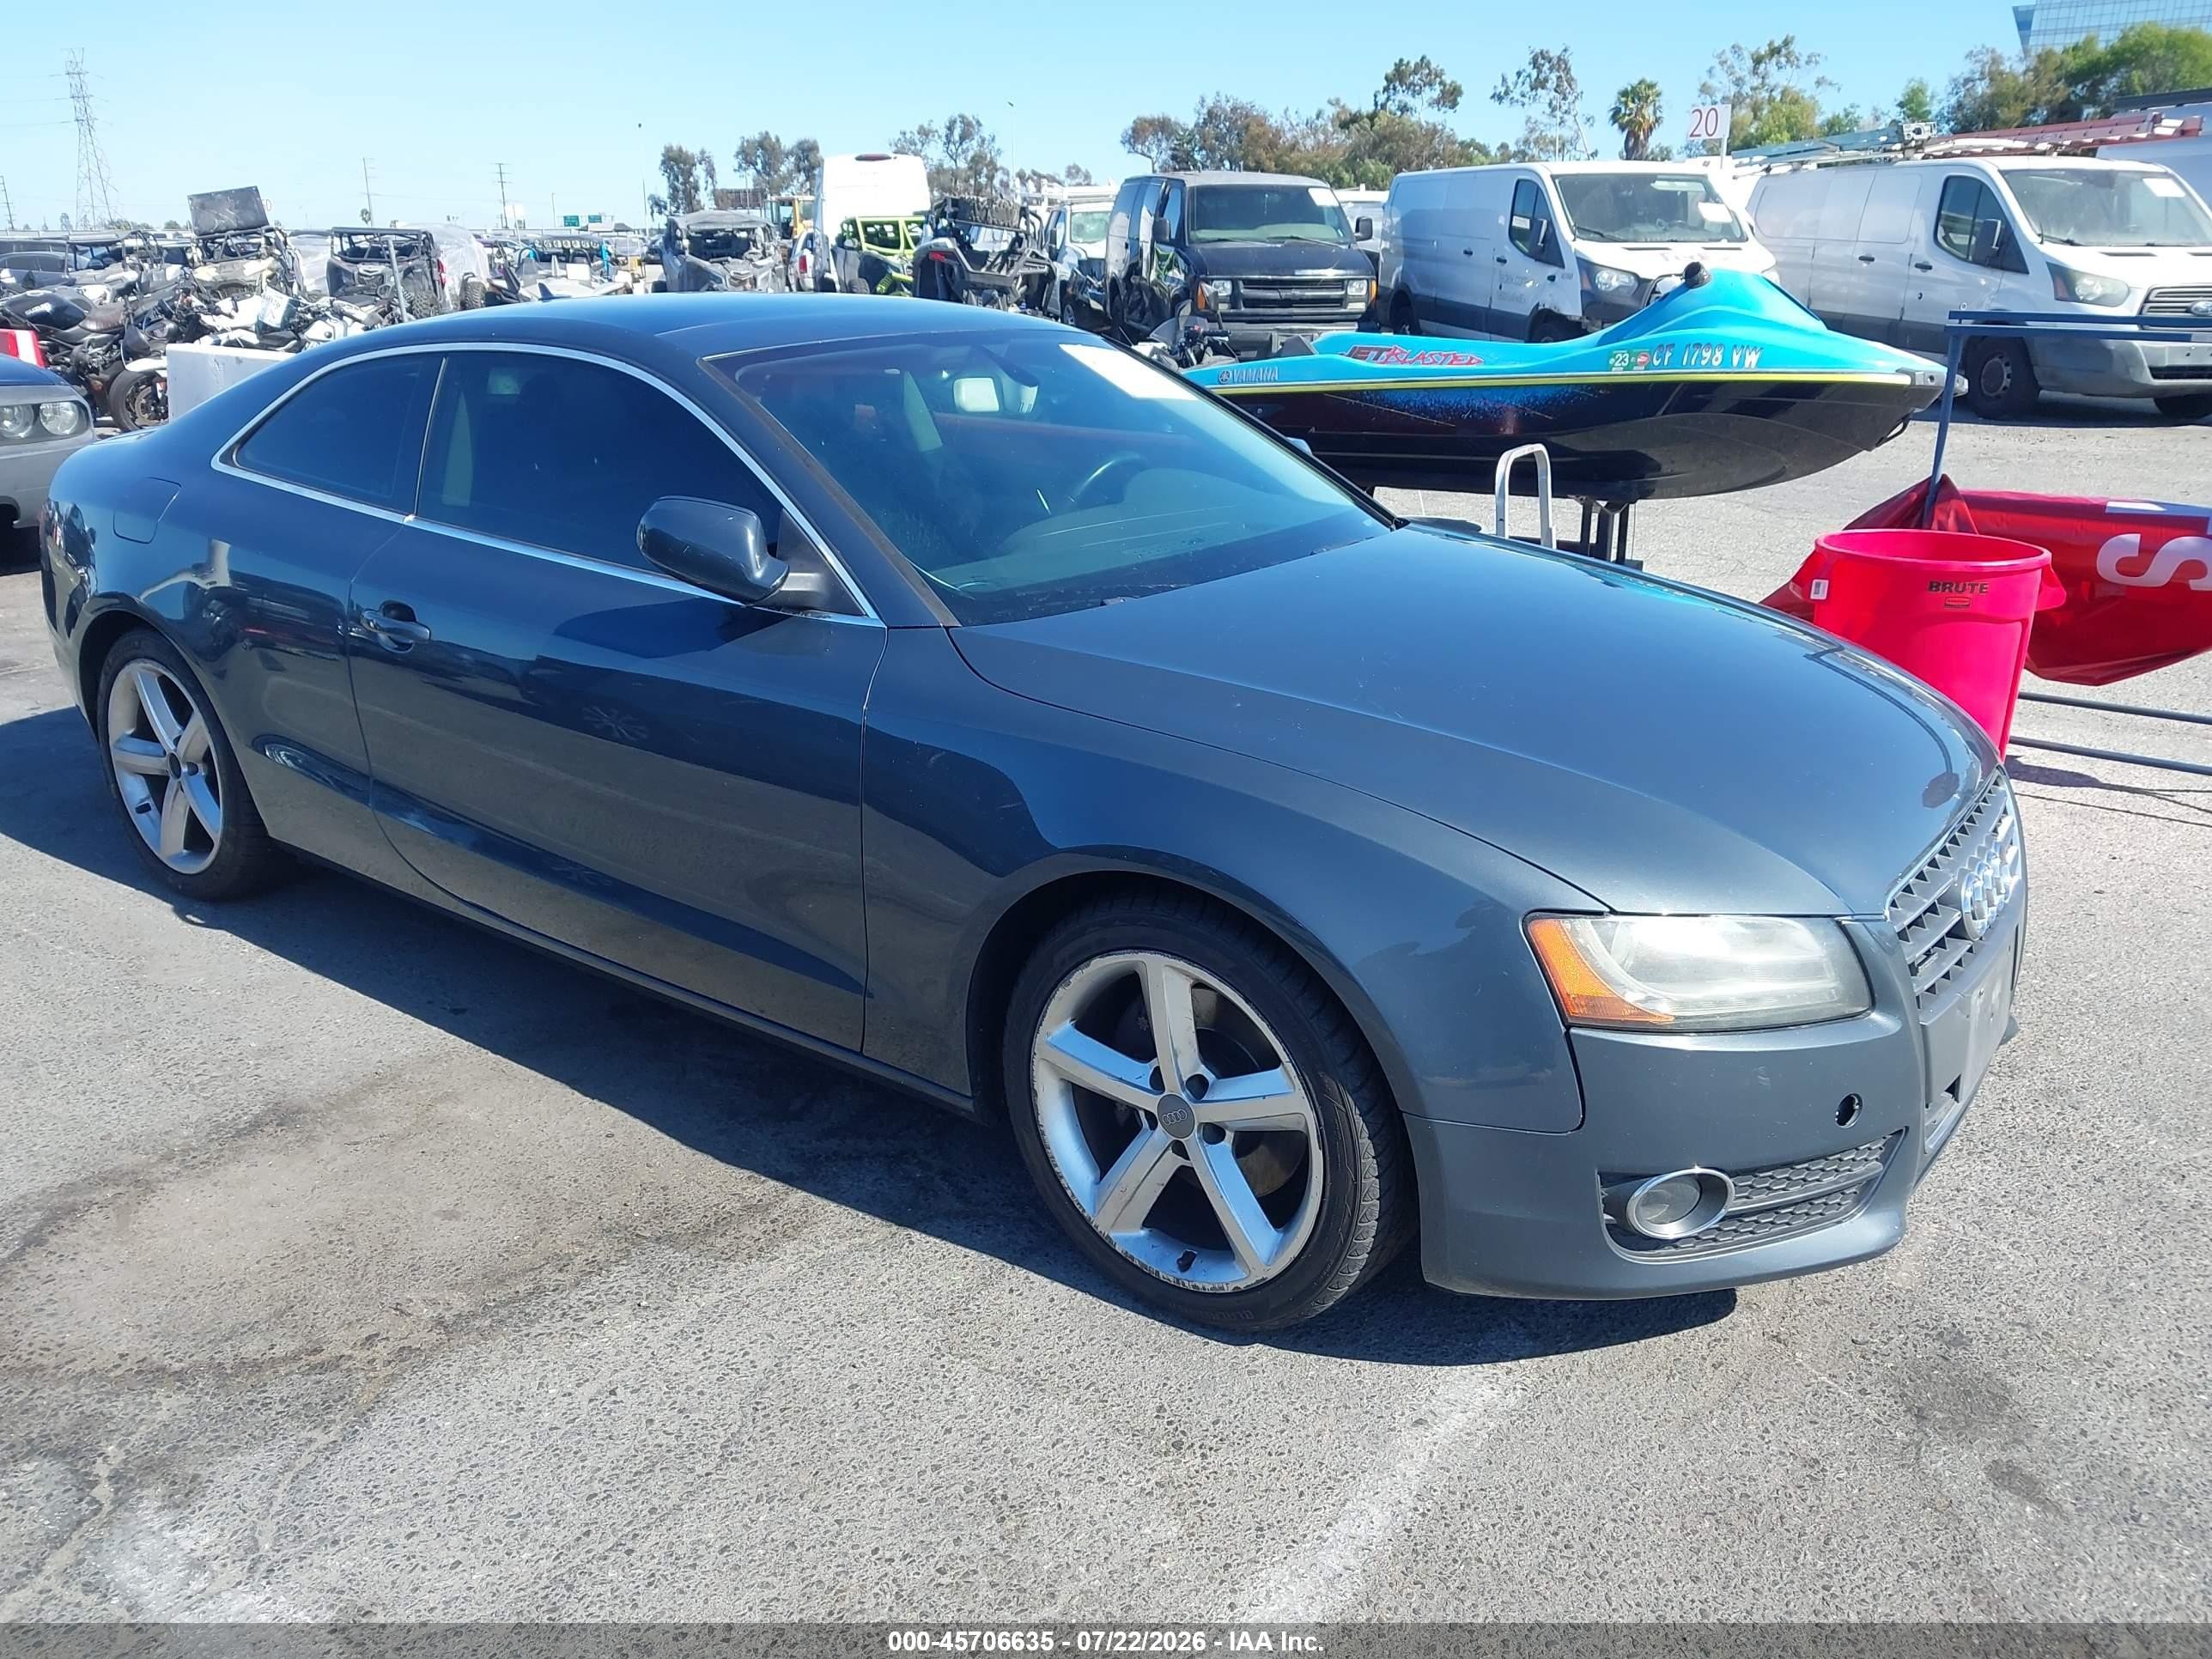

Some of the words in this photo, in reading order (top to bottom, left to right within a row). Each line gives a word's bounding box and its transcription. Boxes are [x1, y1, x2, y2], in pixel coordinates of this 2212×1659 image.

[1690, 107, 1718, 137] 20
[1613, 353, 1630, 367] 23
[1652, 343, 1675, 367] CF
[1682, 343, 1725, 367] 1798
[1732, 343, 1764, 369] VW
[1233, 367, 1279, 383] YAMAHA
[1928, 580, 1990, 594] BRUTE
